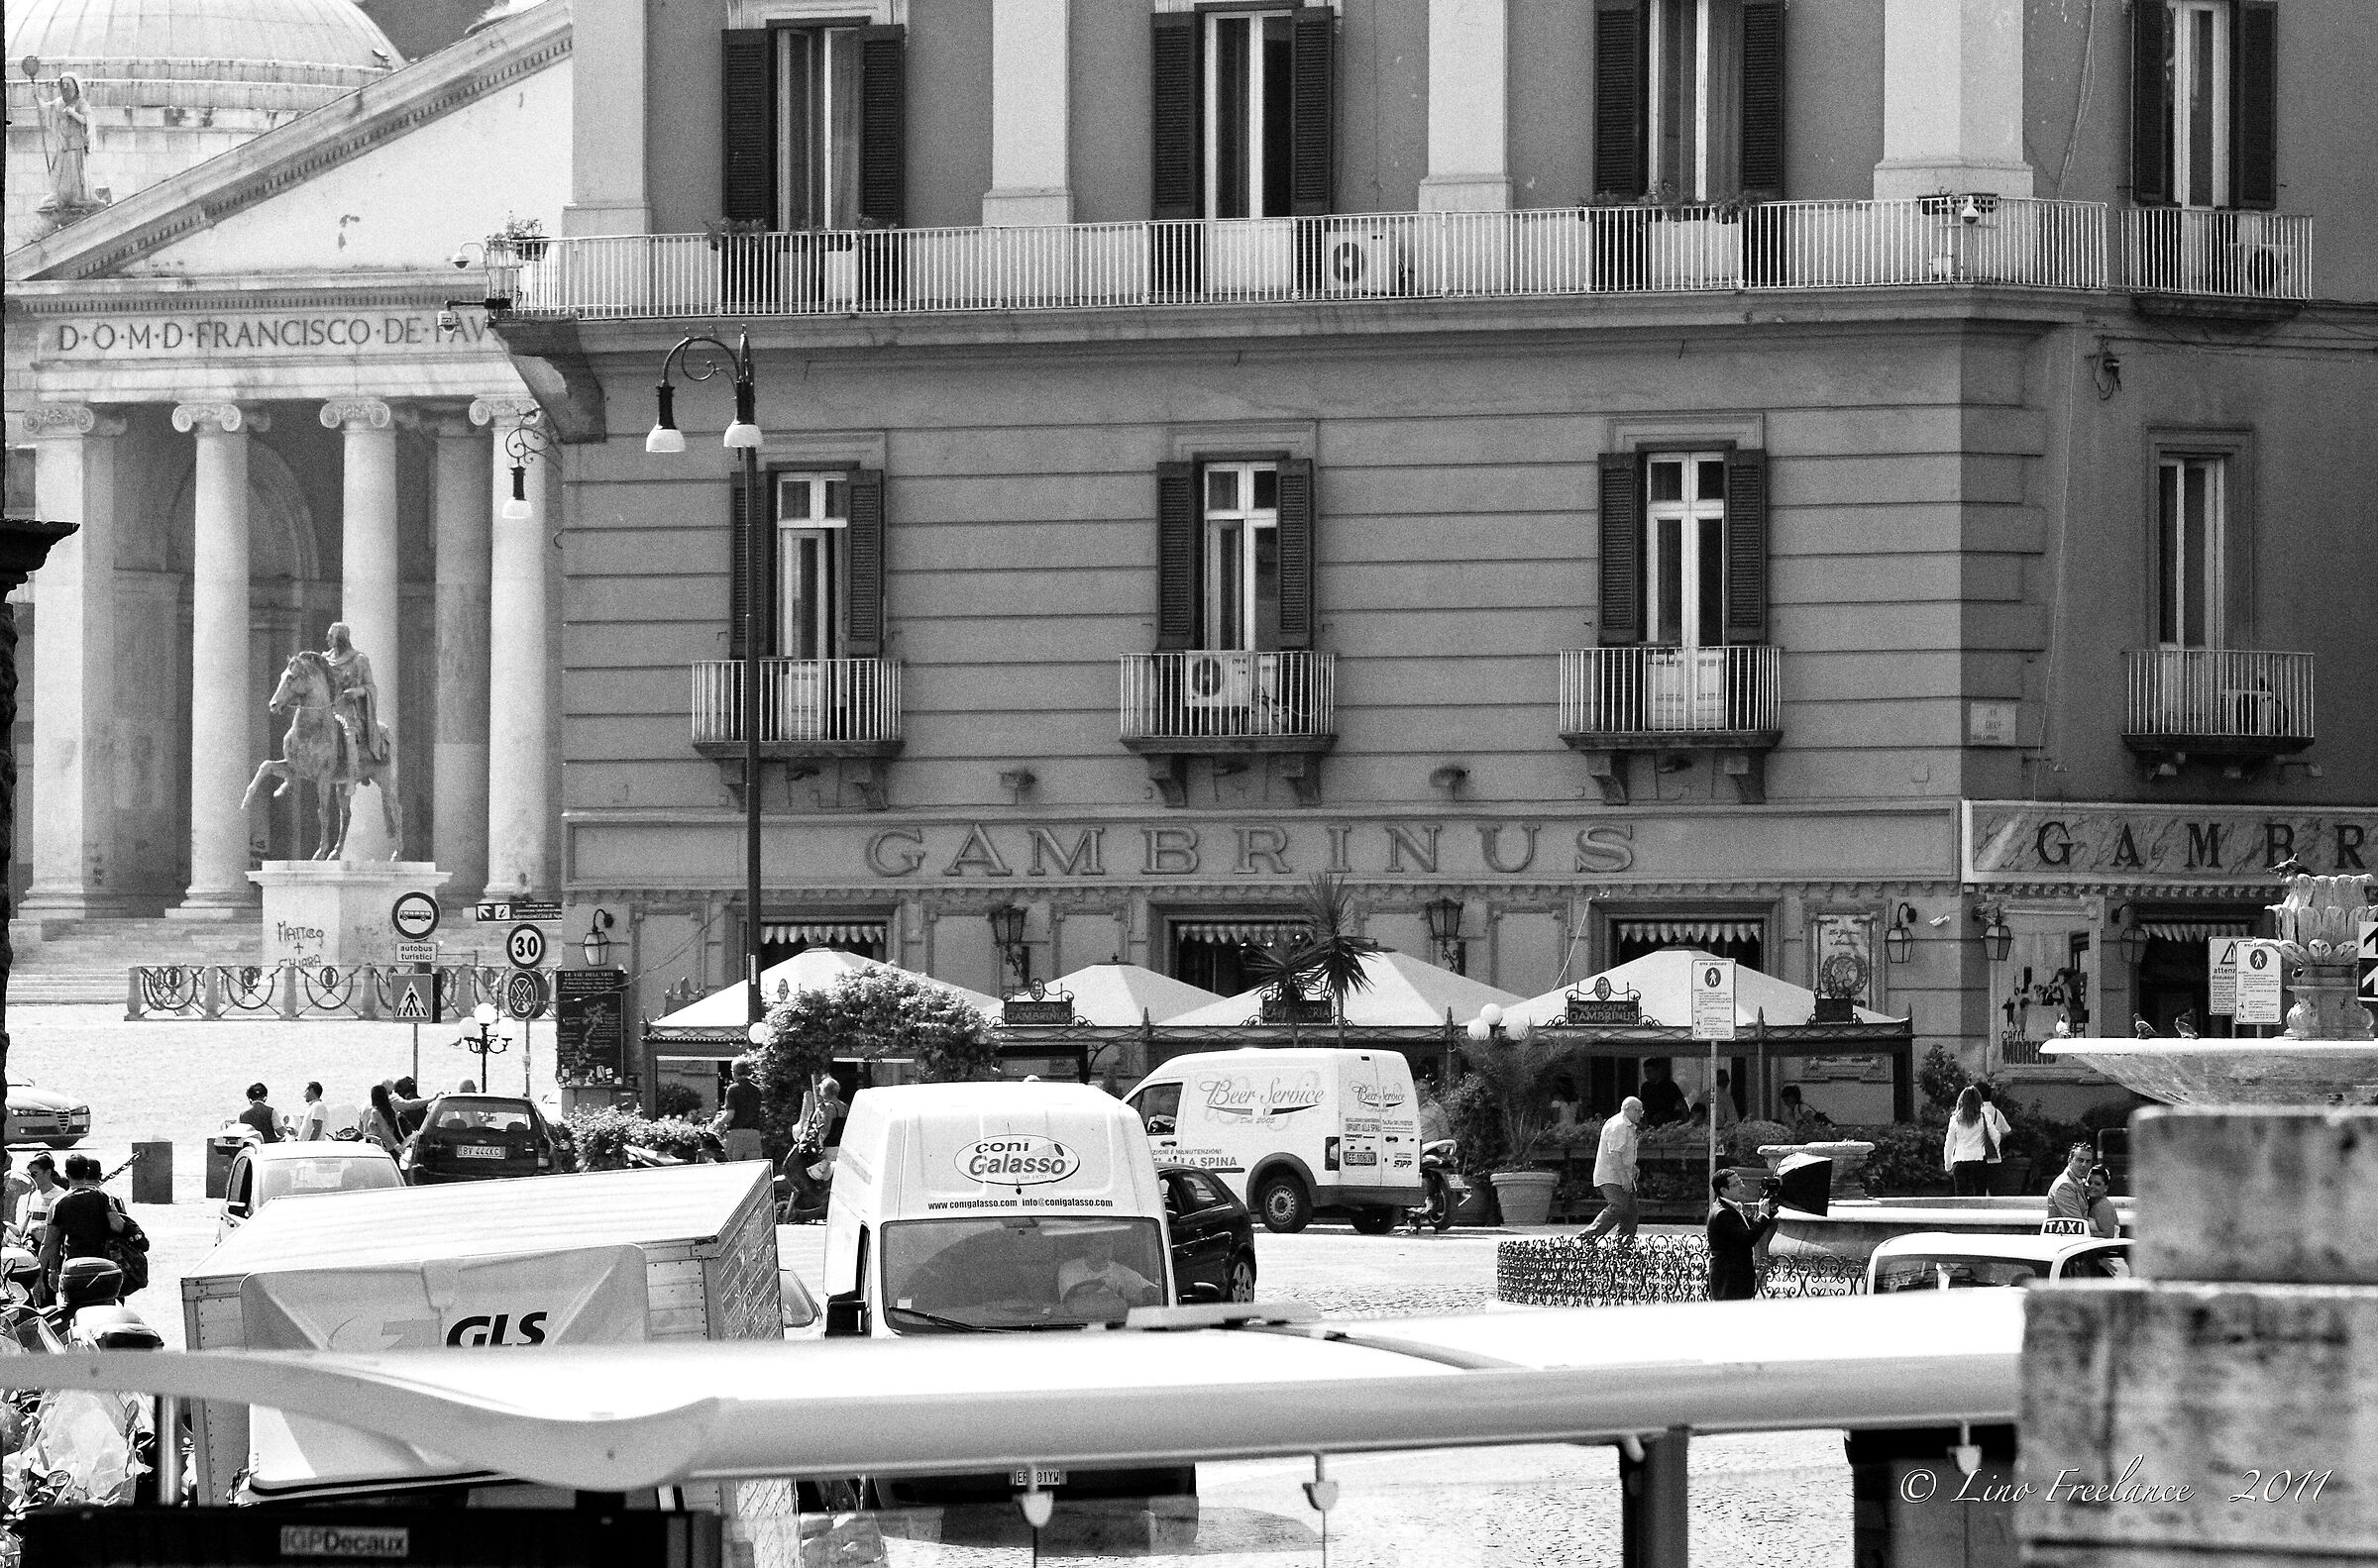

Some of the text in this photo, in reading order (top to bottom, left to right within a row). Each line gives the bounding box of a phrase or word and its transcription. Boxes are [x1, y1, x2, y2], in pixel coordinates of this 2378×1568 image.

[197, 316, 371, 348] FRANCISCO
[865, 822, 1634, 877] GAMBRINUS
[2036, 821, 2365, 870] GAMBR
[515, 936, 538, 958] 30
[1006, 1011, 1069, 1021] GAMBRINUS
[1569, 1011, 1636, 1021] GAMBRINUS
[1200, 1078, 1324, 1104] Beer Service
[975, 1142, 1028, 1154] coni
[969, 1154, 1066, 1176] Galasso
[1200, 1157, 1237, 1166] SPINA
[928, 1197, 1113, 1209] www.conigalasso.com info@conigalasso.com
[2047, 1221, 2083, 1233] TAXI
[446, 1311, 548, 1347] GLS
